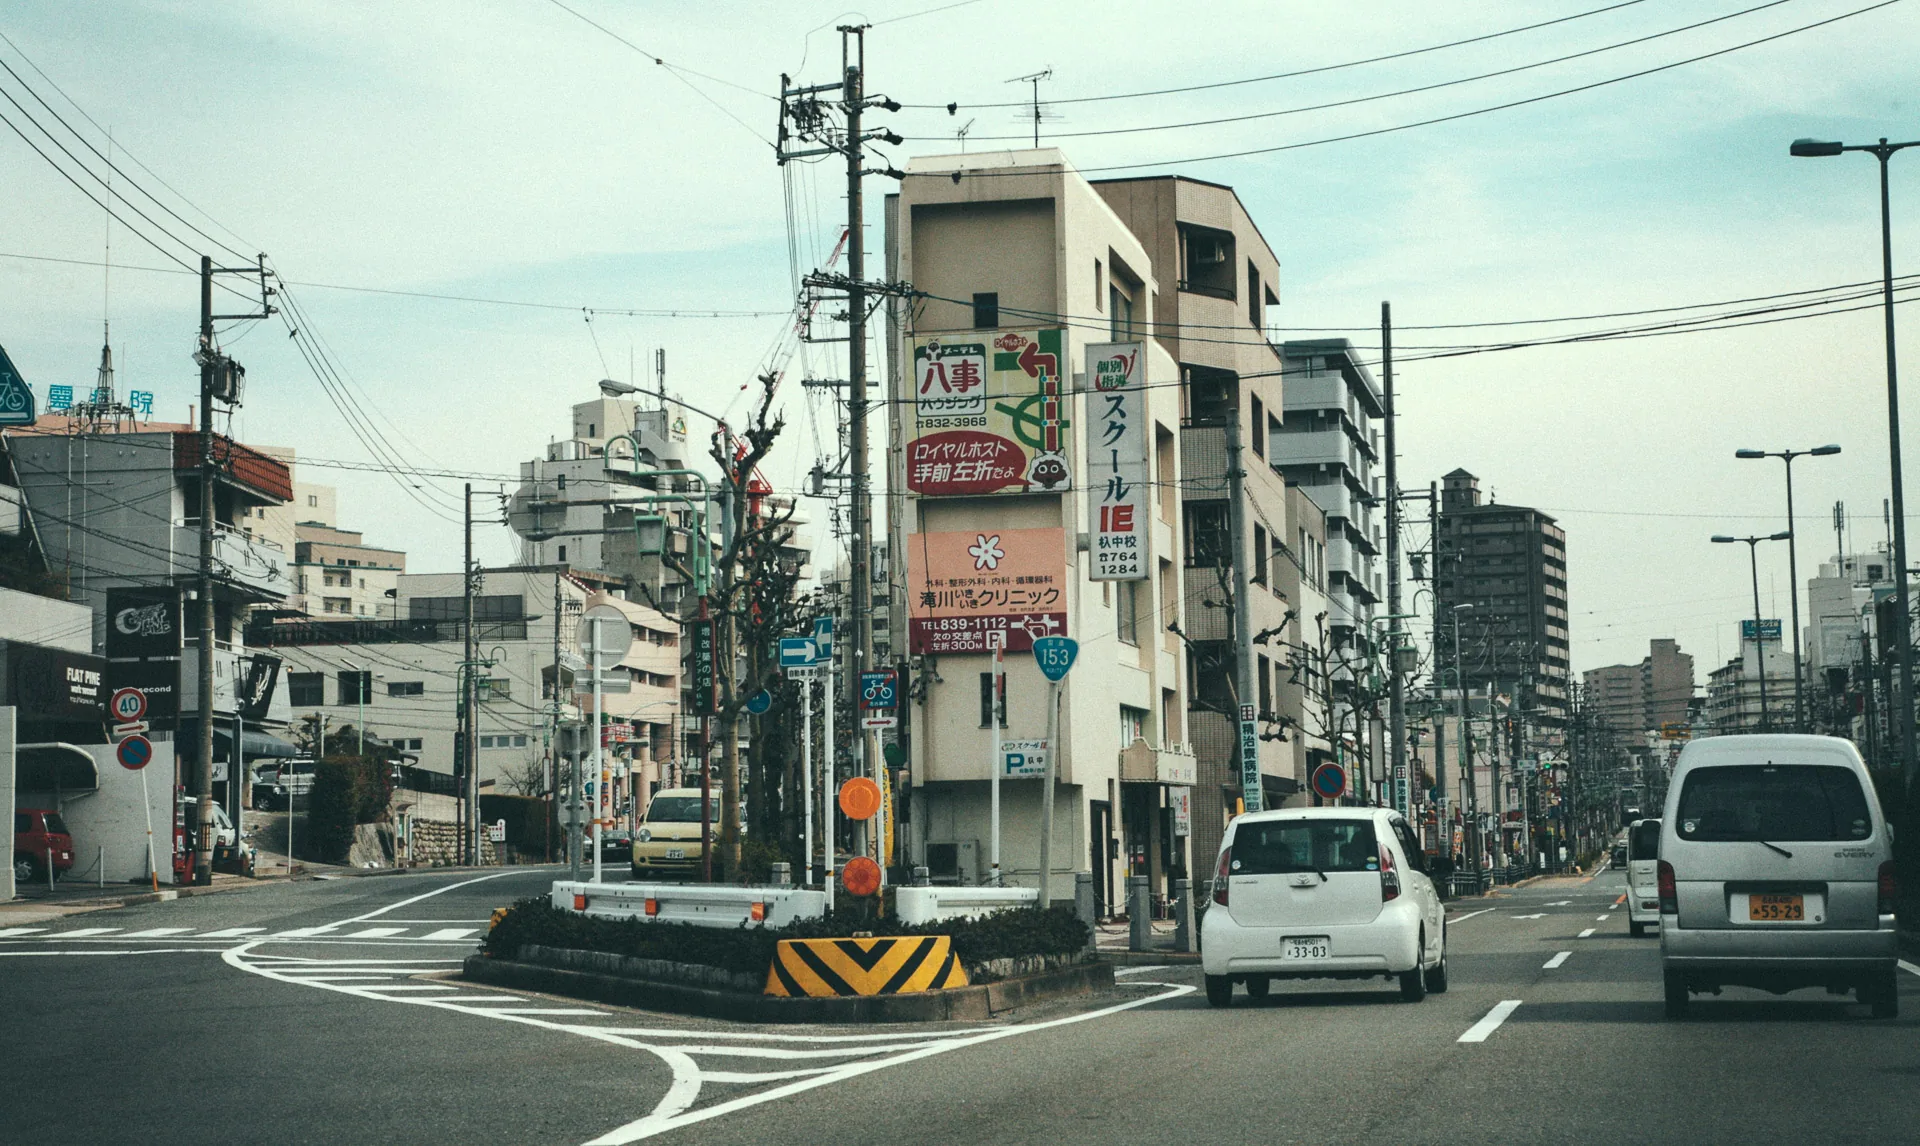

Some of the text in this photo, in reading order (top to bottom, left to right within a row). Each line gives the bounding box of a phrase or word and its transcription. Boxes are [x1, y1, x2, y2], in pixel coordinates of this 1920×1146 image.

[1097, 360, 1122, 374] 個別
[920, 359, 981, 394] 八事
[920, 396, 981, 411] ハウジング
[925, 417, 987, 429] 832-3968
[915, 440, 1008, 460] ロイヤルホスト
[1101, 394, 1131, 503] スクール
[1100, 504, 1134, 533] IE
[1110, 552, 1138, 562] 764
[1101, 564, 1138, 576] 1284
[922, 617, 1007, 631] TEL 839-1112
[1043, 649, 1070, 665] 153
[66, 667, 101, 686] FLAT PINE
[120, 697, 139, 714] 40
[1006, 753, 1025, 774] P
[1762, 904, 1802, 919] 59-29
[1294, 946, 1326, 958] 33-03
